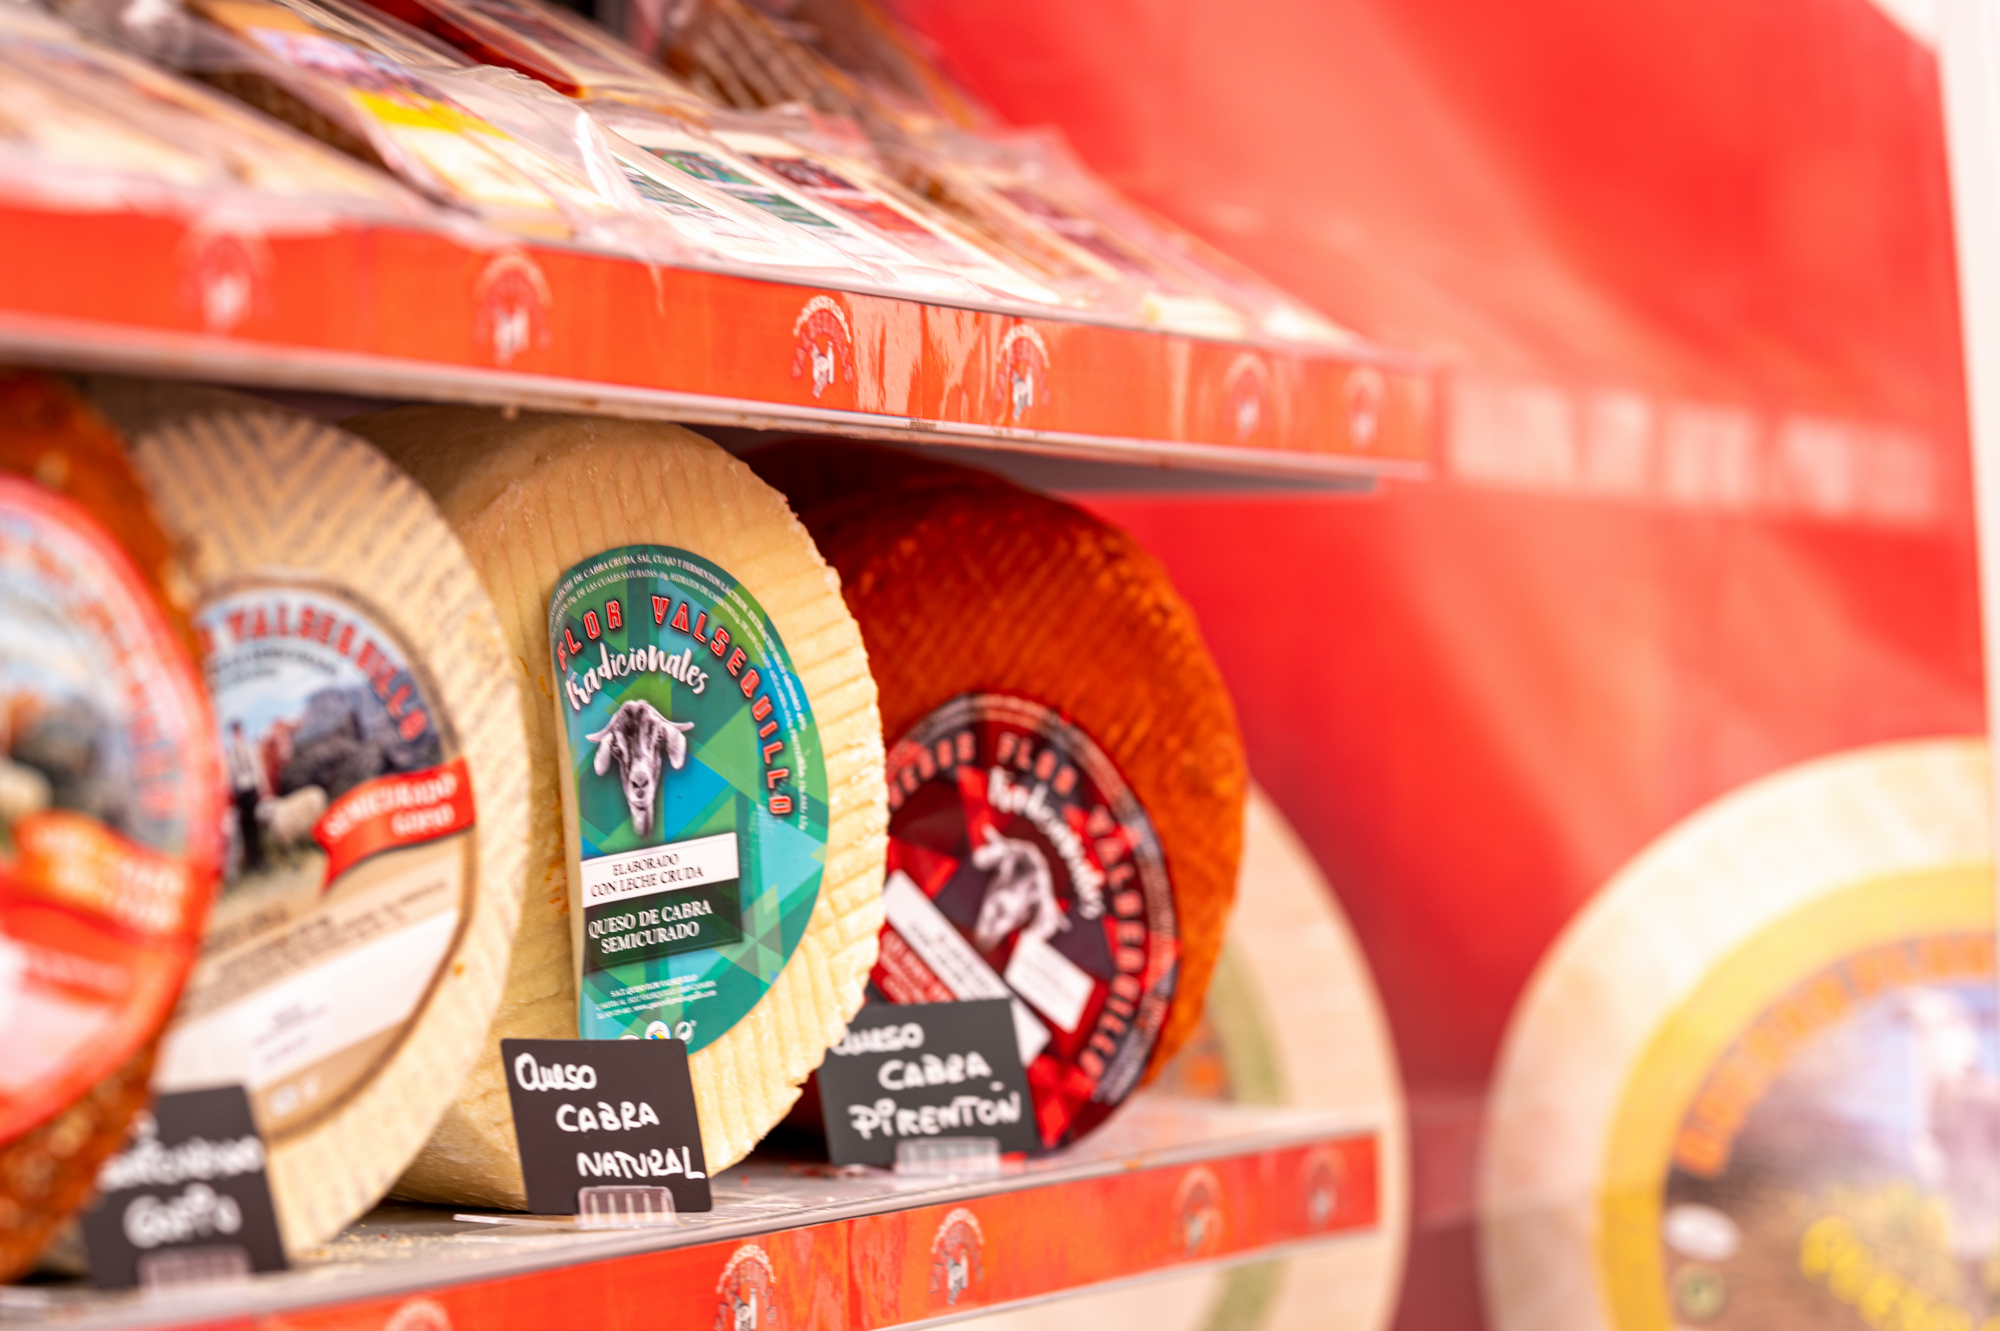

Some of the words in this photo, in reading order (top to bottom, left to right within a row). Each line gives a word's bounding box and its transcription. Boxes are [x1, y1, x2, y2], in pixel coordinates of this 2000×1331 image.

[565, 643, 710, 711] Tradicionales
[556, 600, 623, 672] FLOR
[651, 594, 793, 816] VALSEQUILLO
[590, 880, 617, 897] CON
[619, 873, 659, 892] LECHE
[660, 865, 704, 884] CRUDA
[612, 853, 680, 876] ELABORADO
[588, 911, 637, 940] QUESO
[638, 908, 661, 927] DE
[661, 899, 714, 922] CABRA
[601, 921, 701, 954] SEMICURADO
[555, 1101, 661, 1132] CABRA
[576, 1146, 706, 1179] NATURAL
